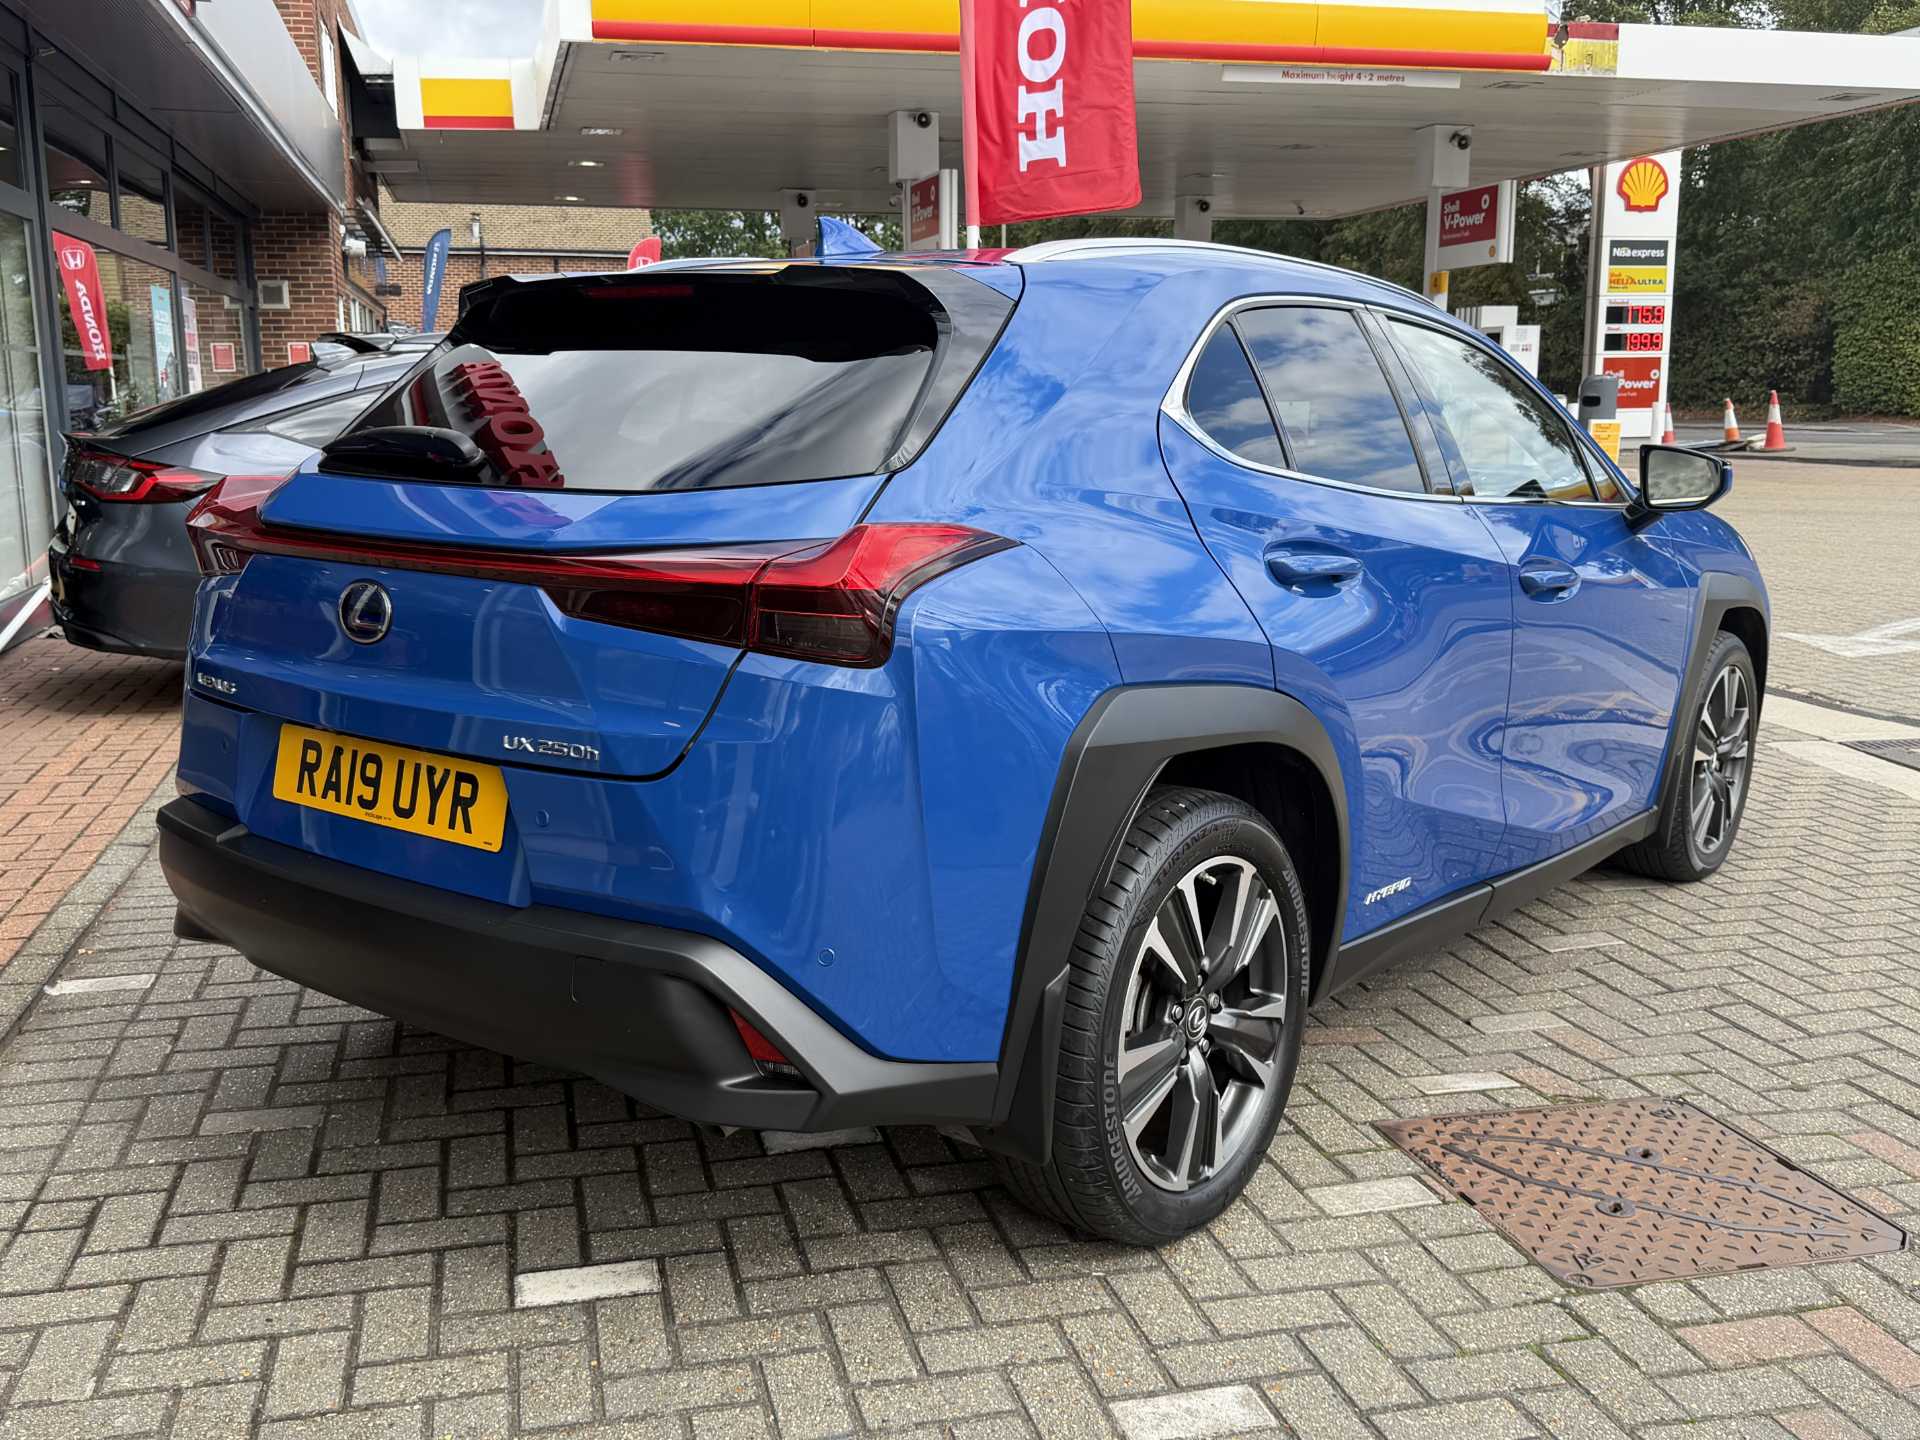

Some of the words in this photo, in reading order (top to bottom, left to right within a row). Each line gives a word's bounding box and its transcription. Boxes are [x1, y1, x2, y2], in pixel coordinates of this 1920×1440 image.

[1018, 0, 1067, 172] HO
[1281, 69, 1325, 81] Maximum
[1327, 71, 1354, 82] height
[1376, 74, 1406, 83] metres
[1443, 200, 1460, 214] Shell
[1443, 212, 1486, 230] V-Power
[1628, 305, 1664, 324] 175.9
[1626, 332, 1663, 352] 199.9
[1617, 379, 1656, 390] Power
[197, 672, 238, 694] LEXUS
[503, 735, 535, 753] UX
[538, 738, 600, 761] 250h
[297, 738, 383, 811] RA19
[393, 759, 480, 834] UYR
[1103, 1054, 1143, 1204] BRIDGESTONE
